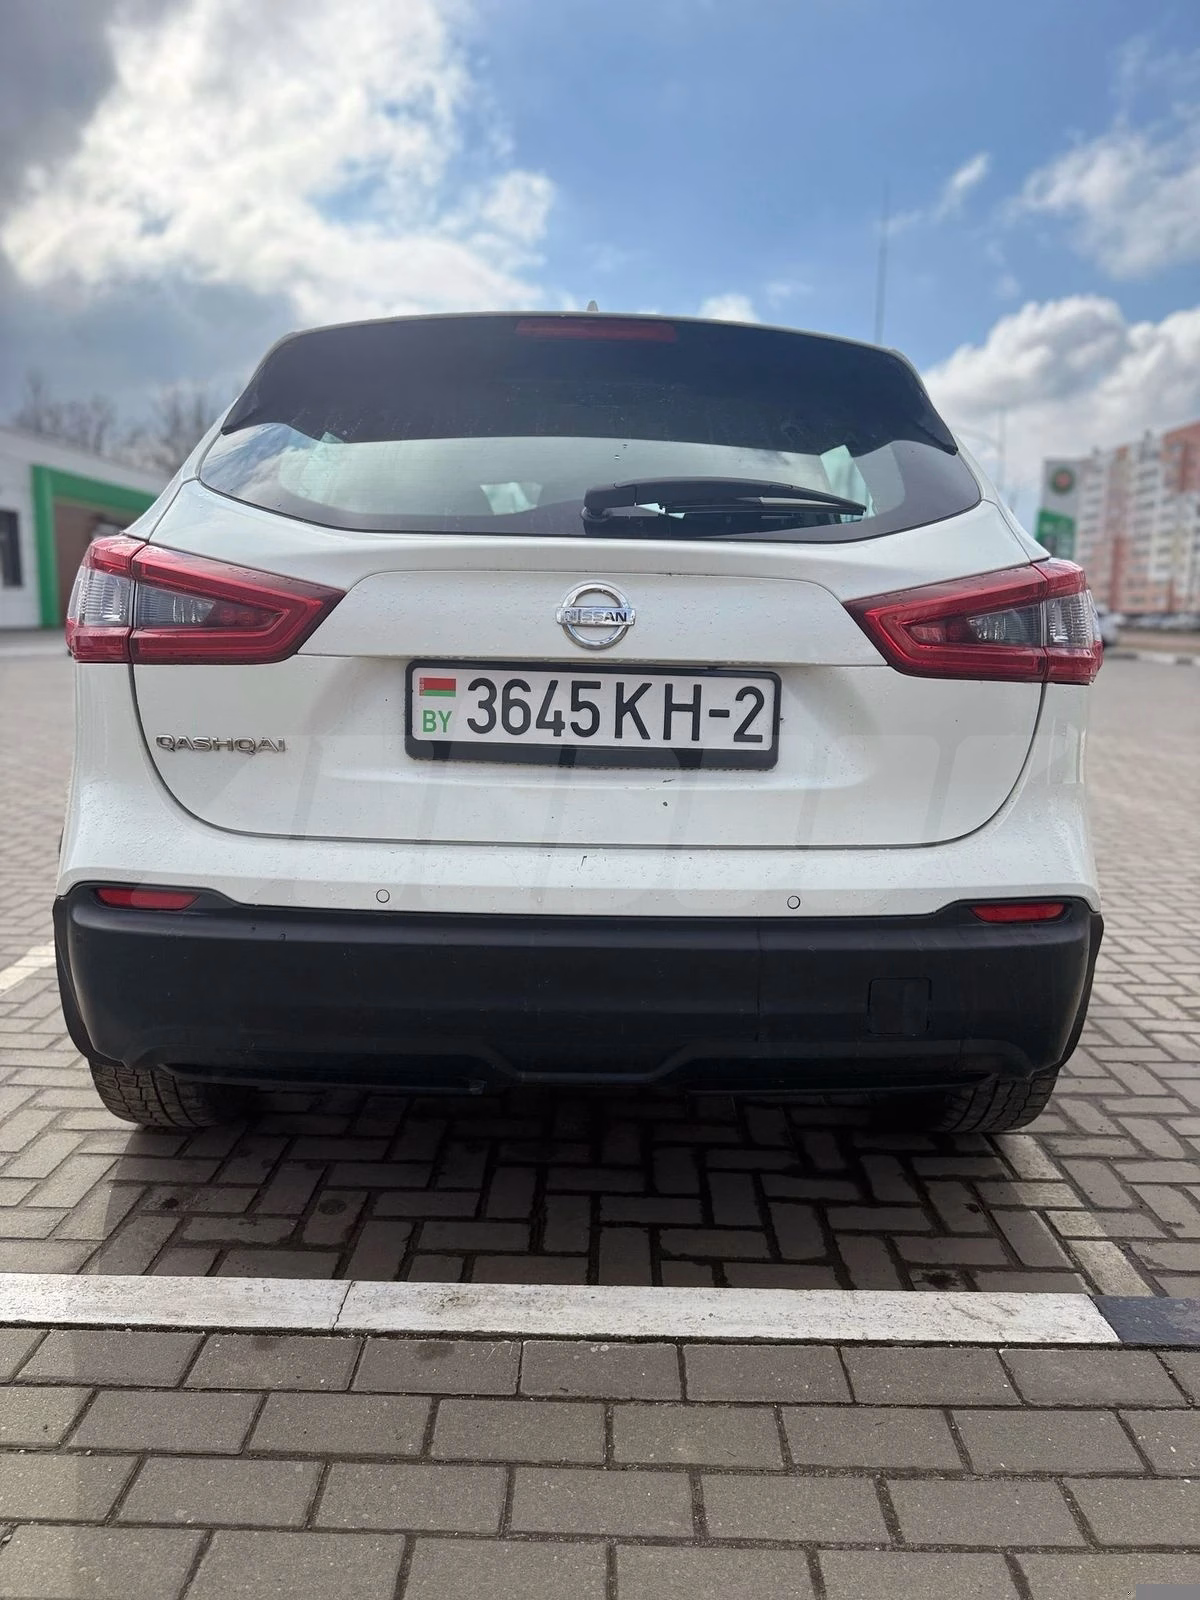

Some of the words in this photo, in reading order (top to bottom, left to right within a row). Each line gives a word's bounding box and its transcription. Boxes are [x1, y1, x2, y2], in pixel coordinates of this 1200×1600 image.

[563, 609, 628, 623] NISSAN
[422, 709, 453, 733] BY
[155, 734, 286, 755] QASHQAI
